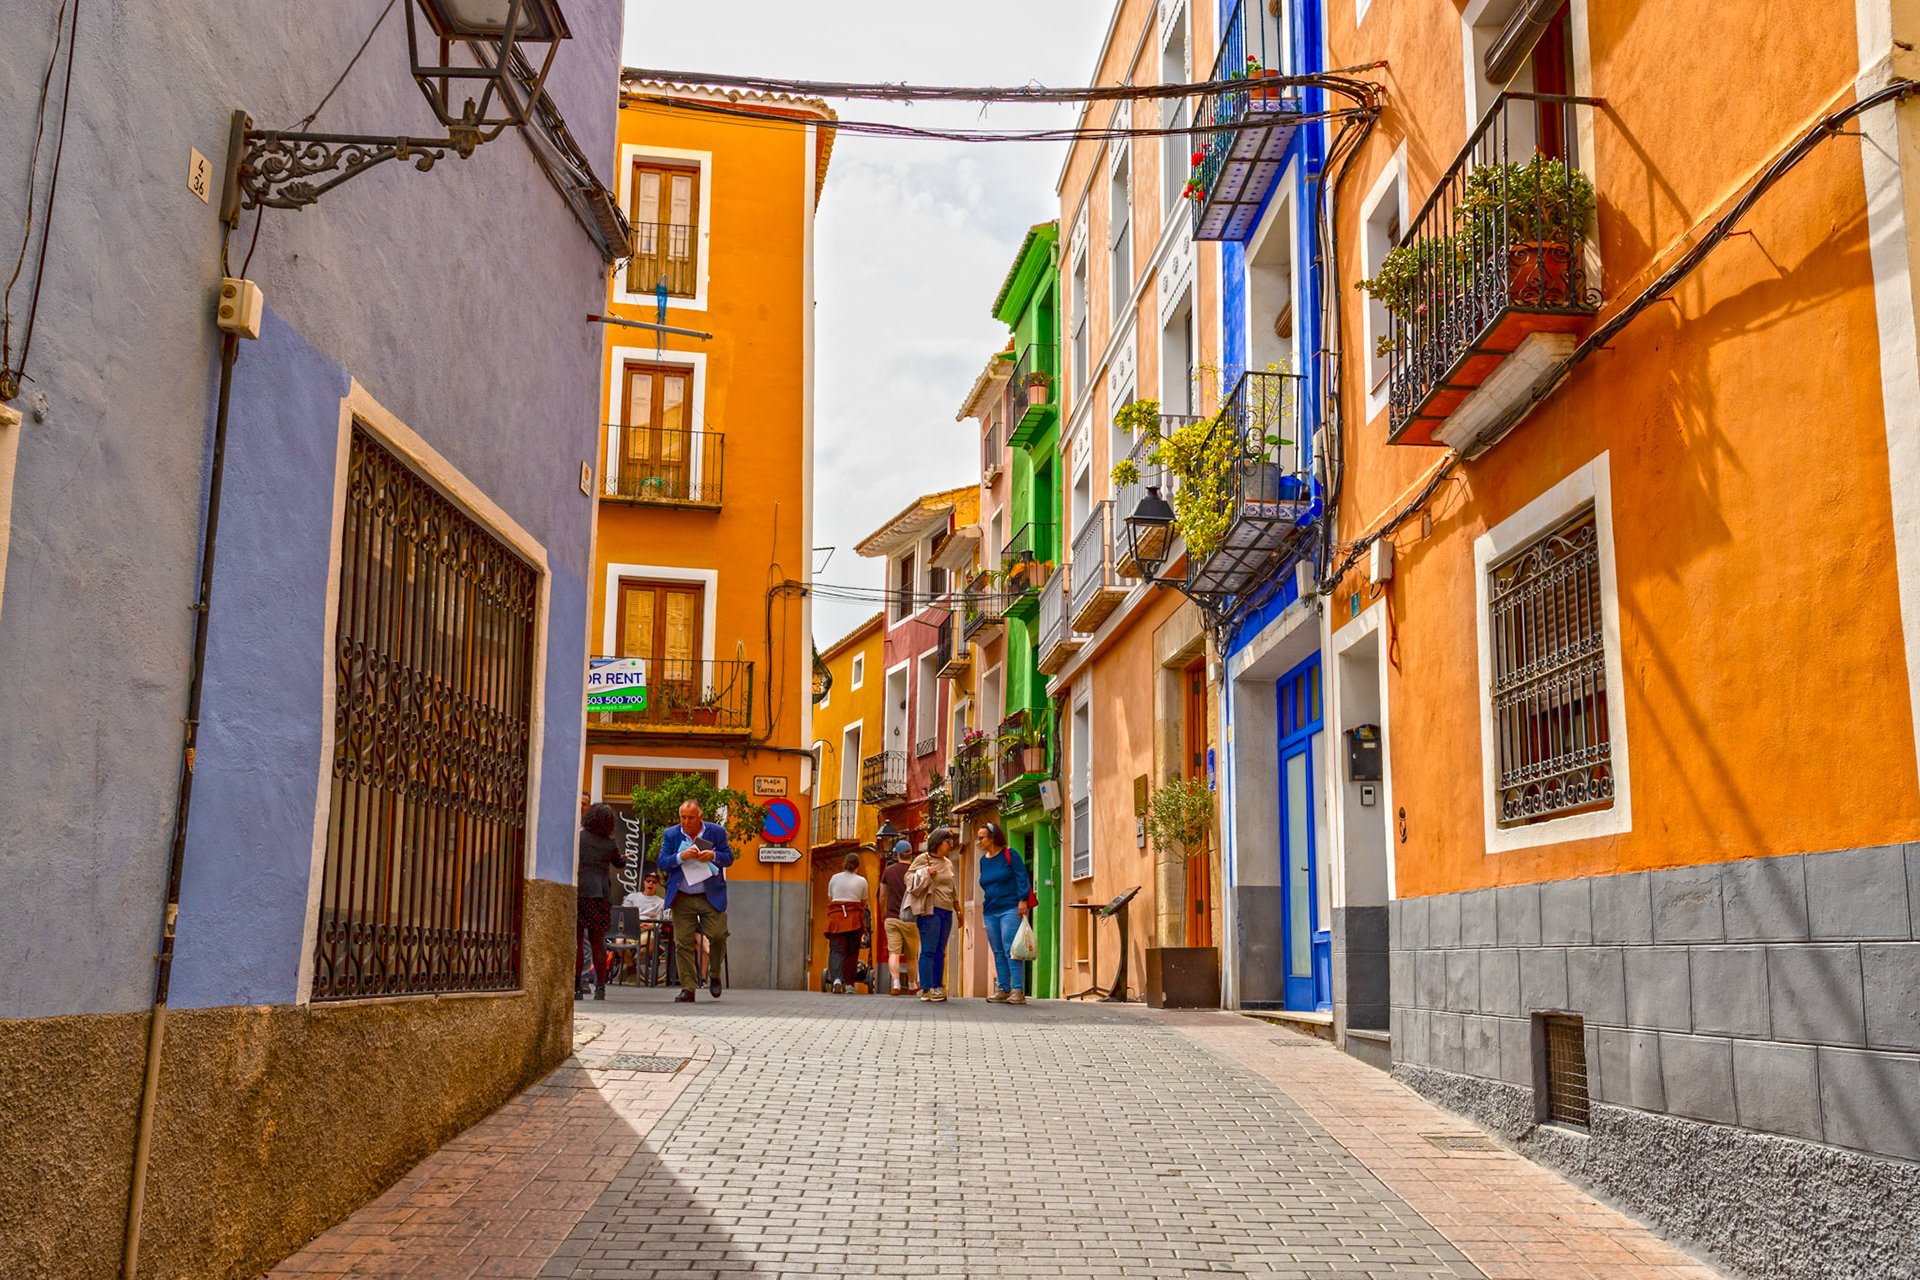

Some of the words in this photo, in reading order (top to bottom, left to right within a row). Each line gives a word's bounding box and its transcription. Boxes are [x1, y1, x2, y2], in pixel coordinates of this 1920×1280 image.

[198, 159, 204, 174] 4
[193, 175, 204, 196] 36
[606, 673, 642, 684] RENT
[605, 696, 624, 704] 500
[626, 696, 643, 704] 700
